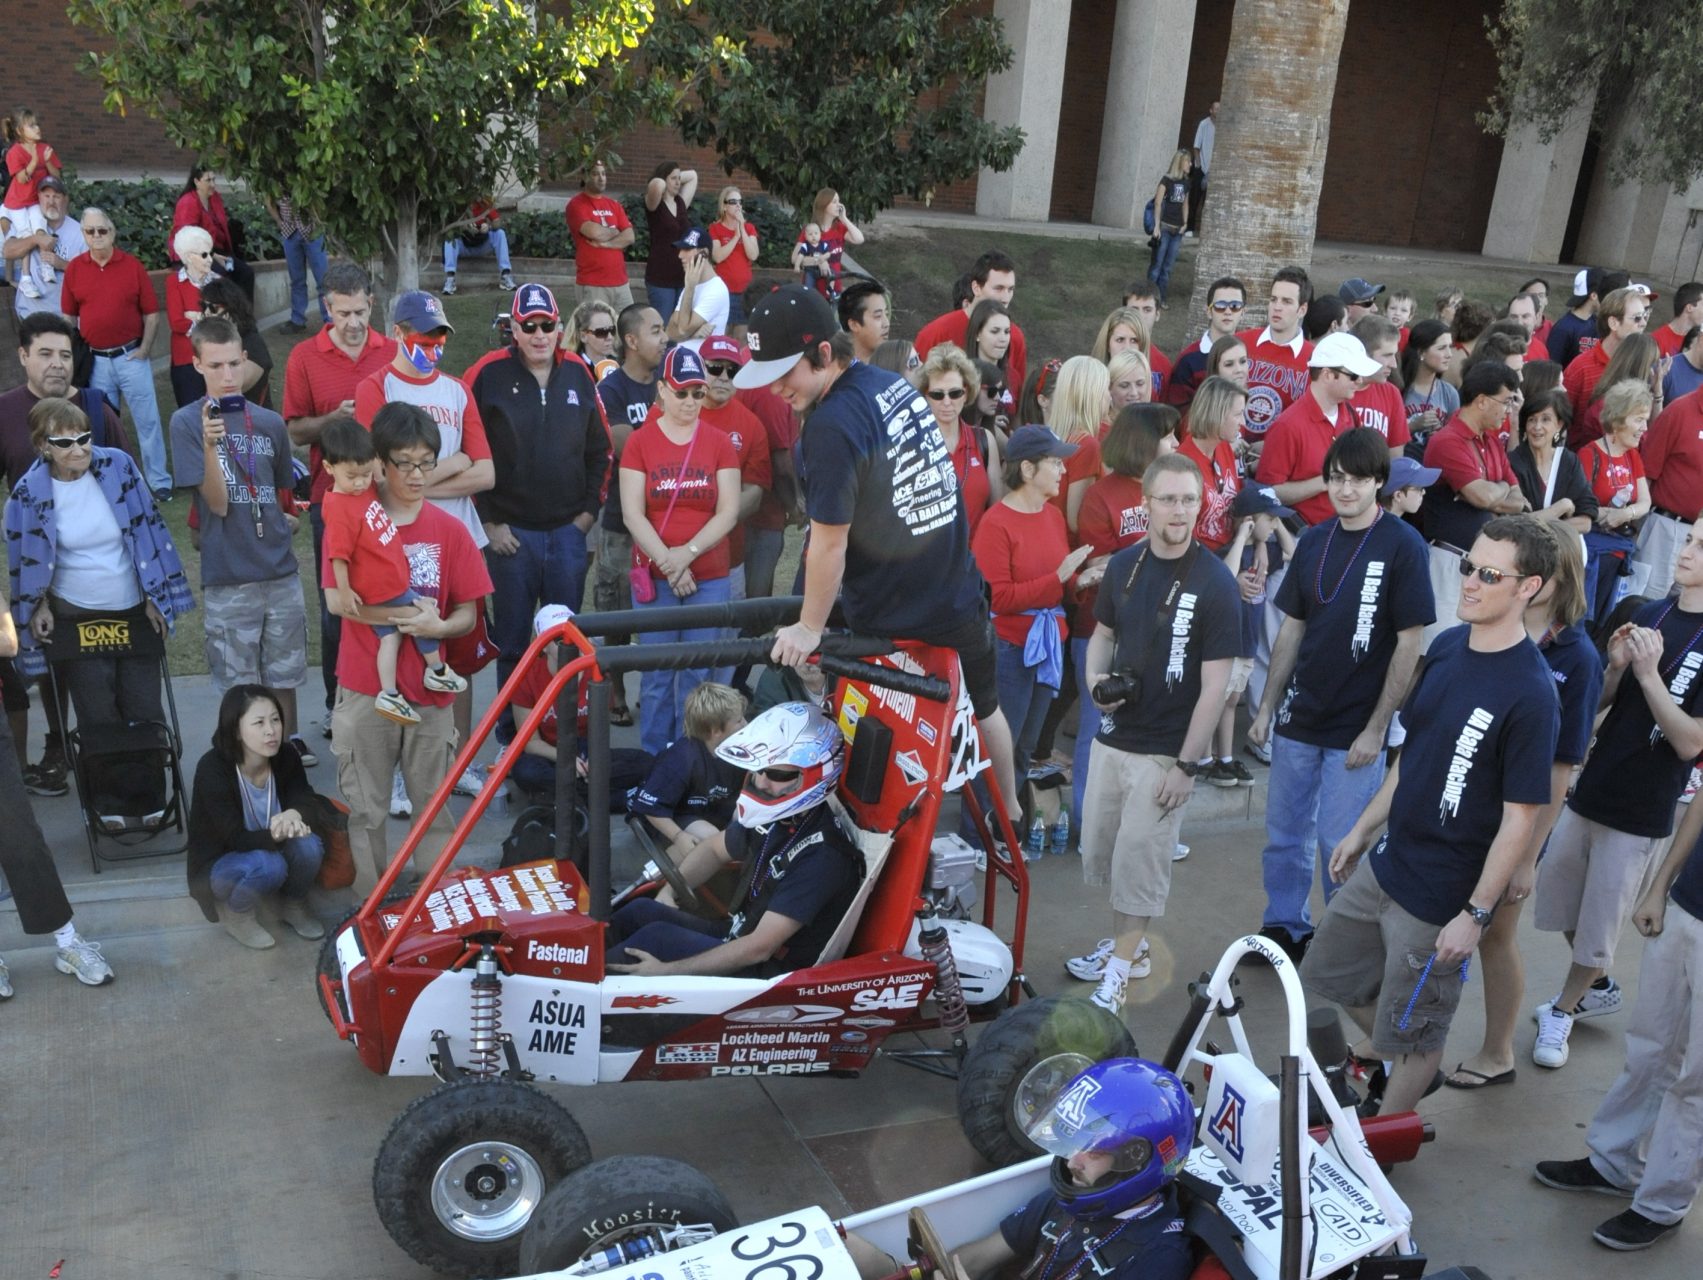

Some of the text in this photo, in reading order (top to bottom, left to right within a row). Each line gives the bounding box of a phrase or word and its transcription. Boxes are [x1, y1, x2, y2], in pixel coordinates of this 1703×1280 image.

[1246, 359, 1309, 401] RIZONA
[1355, 407, 1389, 438] ZONA
[1351, 560, 1385, 664] UA Baja Racing
[79, 623, 129, 647] LONG
[1165, 592, 1198, 693] UA Baja Racing
[1439, 707, 1495, 826] UA Baja Racing
[527, 940, 590, 965] Fastenal
[797, 988, 816, 997] THE
[817, 979, 873, 995] UNIVERSITY
[850, 983, 925, 1011] SAE
[529, 999, 586, 1029] ASUA
[528, 1029, 578, 1055] AME
[722, 1031, 831, 1046] Lockheed Martin
[711, 1062, 831, 1077] POLARIS
[731, 1049, 748, 1063] AZ
[749, 1047, 818, 1064] Engineering
[1055, 1075, 1102, 1130] A
[1207, 1082, 1246, 1164] A
[1319, 1162, 1375, 1212] DIVERSIFIED
[582, 1201, 683, 1241] Hoosier
[1234, 1213, 1260, 1236] Pool
[1319, 1203, 1363, 1241] CAID
